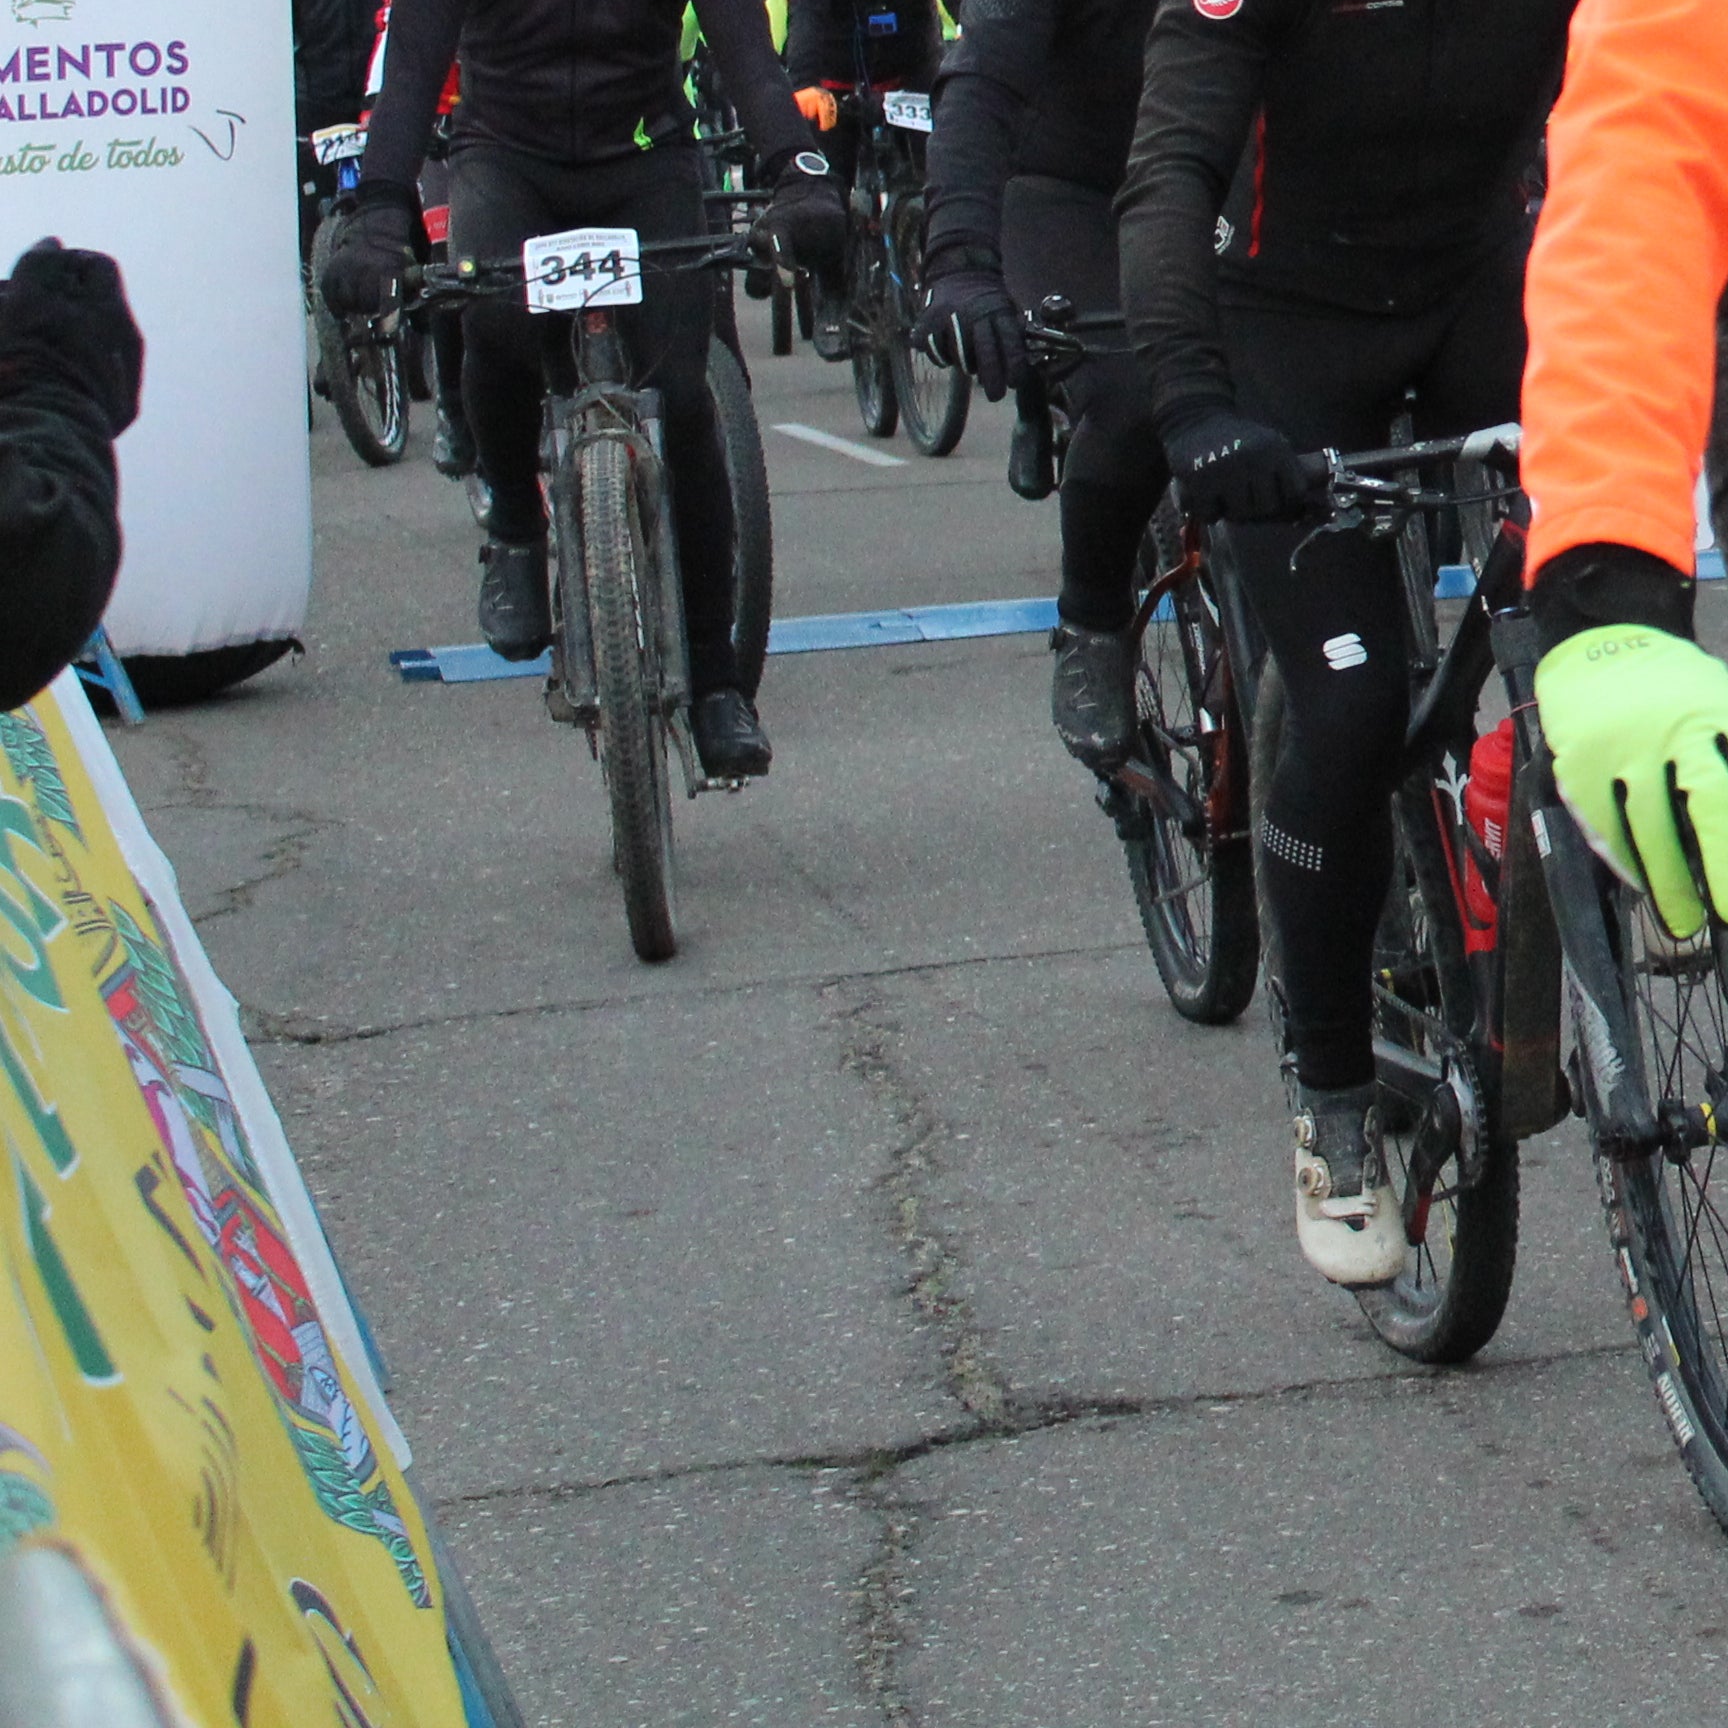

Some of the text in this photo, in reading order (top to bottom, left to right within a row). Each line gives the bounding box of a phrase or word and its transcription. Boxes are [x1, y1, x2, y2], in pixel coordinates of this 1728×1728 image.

[49, 138, 101, 172] de
[106, 136, 186, 170] todos
[540, 249, 625, 286] 344
